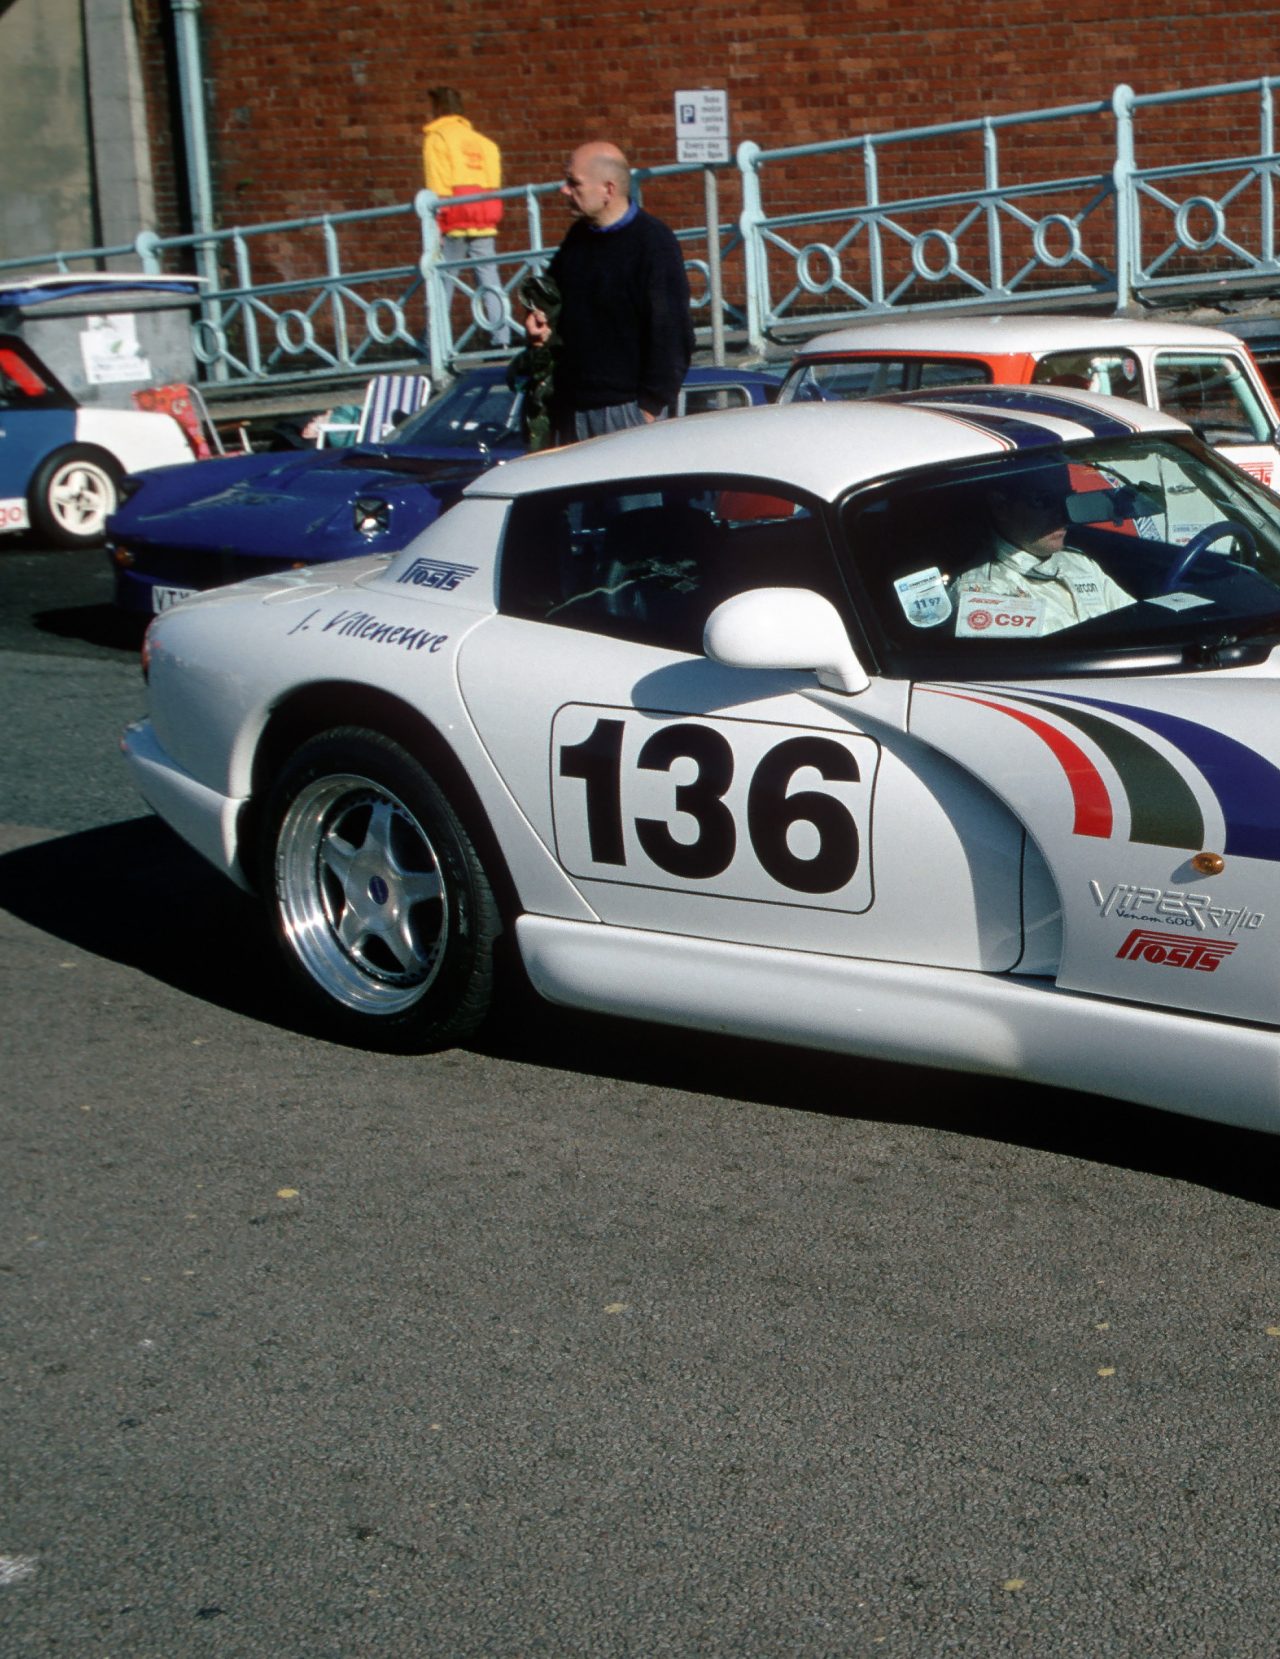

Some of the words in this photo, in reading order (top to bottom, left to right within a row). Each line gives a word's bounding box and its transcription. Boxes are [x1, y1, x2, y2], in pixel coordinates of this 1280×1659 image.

[322, 609, 448, 653] Villeneuve
[994, 613, 1037, 628] C97
[559, 717, 861, 895] 136
[1116, 908, 1163, 924] Venom
[1115, 928, 1239, 973] Frosts
